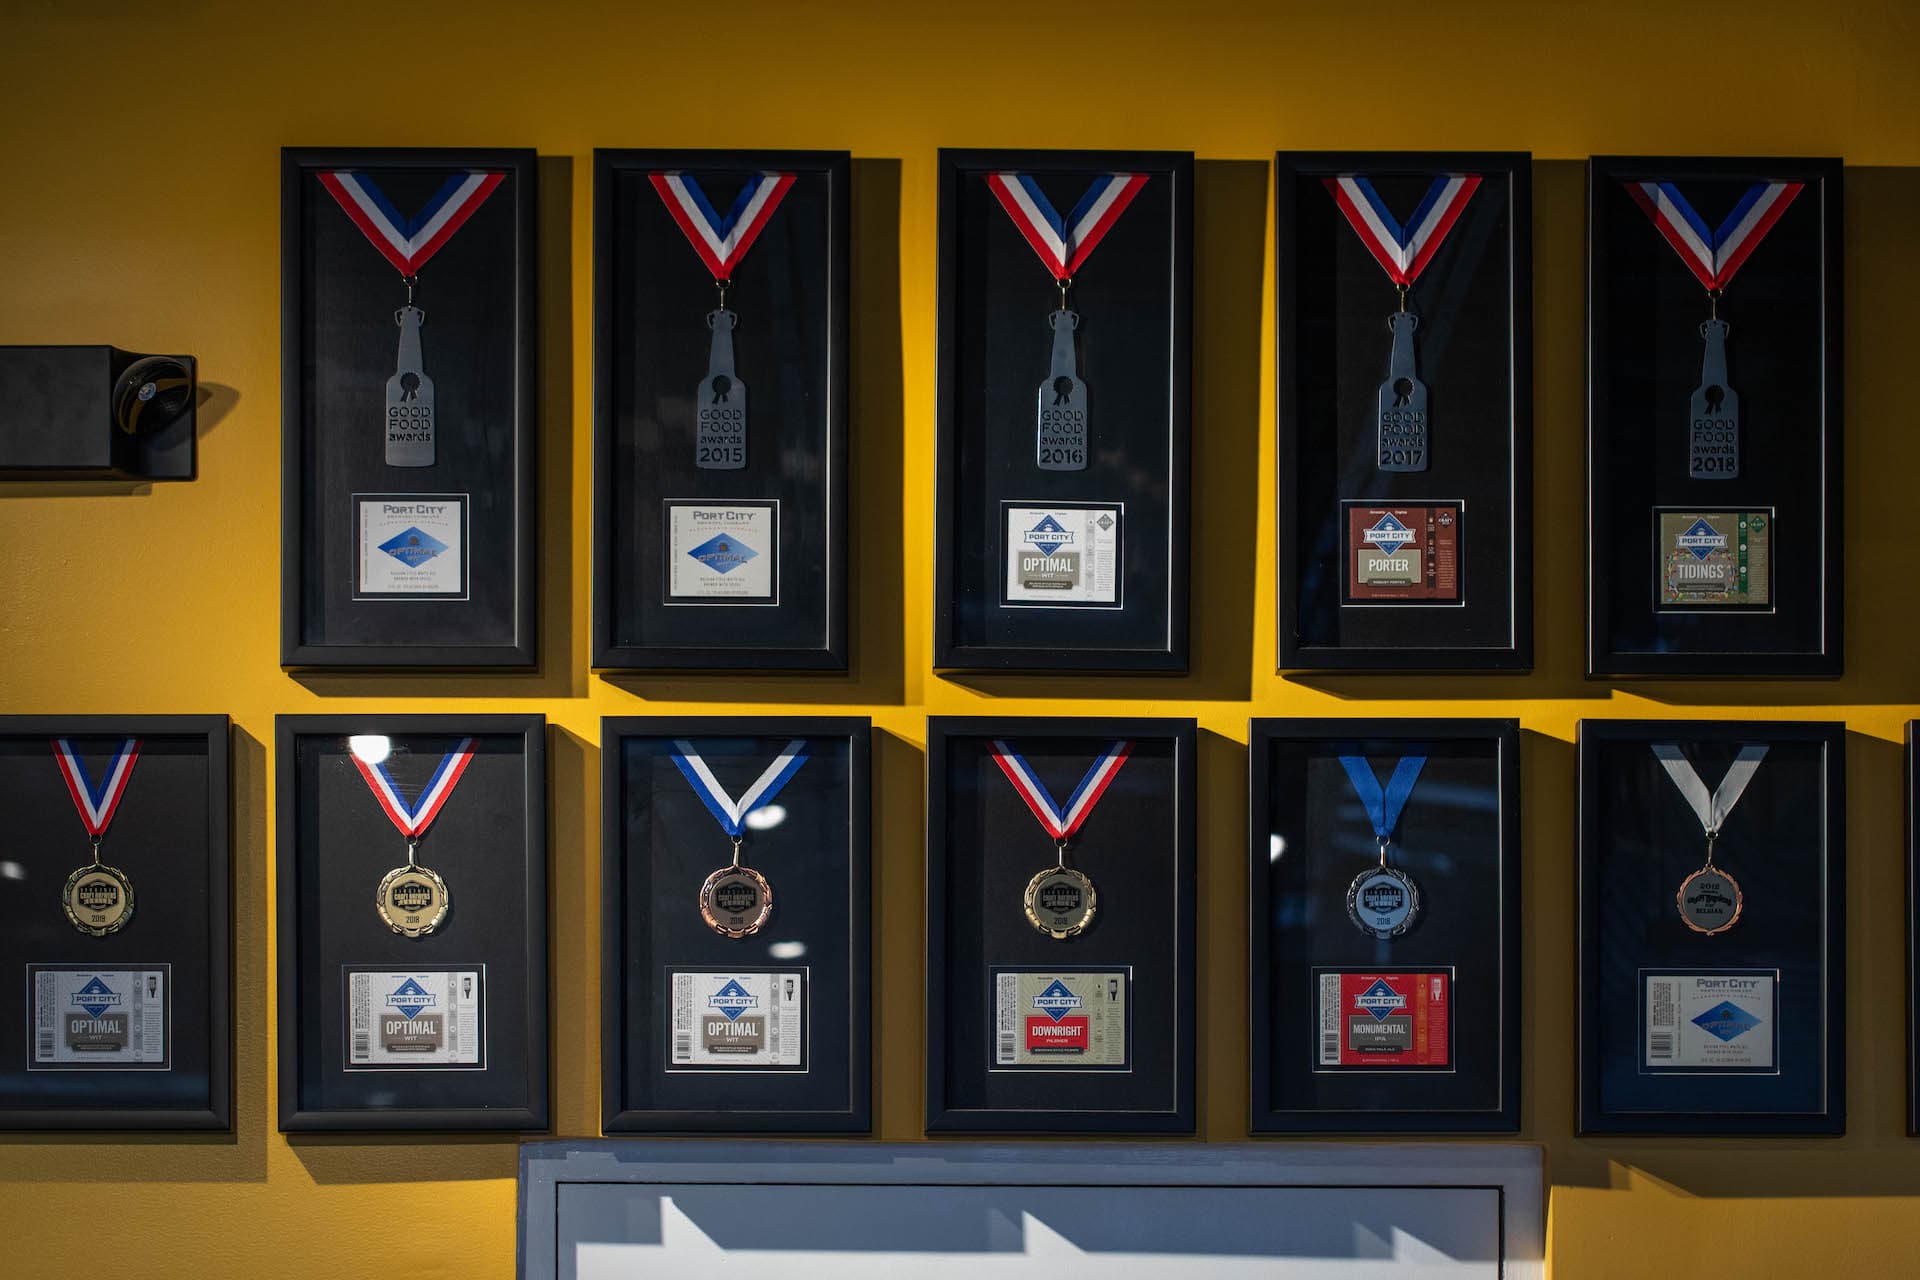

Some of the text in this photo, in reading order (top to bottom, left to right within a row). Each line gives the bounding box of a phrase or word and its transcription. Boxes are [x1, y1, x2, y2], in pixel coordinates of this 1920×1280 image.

[389, 406, 431, 417] GOOD
[700, 409, 742, 420] GOOD
[1042, 410, 1083, 421] GOOD
[1383, 411, 1425, 423] GOOD
[389, 419, 431, 430] FOOD
[701, 422, 742, 432] FOOD
[1042, 423, 1083, 434] FOOD
[1383, 424, 1425, 435] FOOD
[1694, 419, 1736, 430] GOOD
[389, 431, 431, 442] awards
[700, 433, 742, 444] awards
[1041, 435, 1083, 446] awards
[1382, 436, 1424, 448] awards
[1694, 431, 1735, 442] FOOD
[700, 447, 743, 462] 2015
[1041, 448, 1083, 464] 2016
[1382, 450, 1423, 465] 2017
[1693, 457, 1736, 472] 2018
[383, 504, 444, 514] PORT CITY
[693, 511, 753, 521] PORT CITY
[1023, 557, 1073, 572] OPTIMAL
[1369, 559, 1409, 572] PORTER
[1678, 564, 1724, 579] TIDINGS
[1696, 978, 1757, 988] PORT CITY
[71, 1020, 121, 1034] OPTIMAL
[386, 1021, 436, 1035] OPTIMAL
[708, 1022, 758, 1036] OPTIMAL
[1032, 1026, 1081, 1037] DOWNRIGHT
[1353, 1024, 1406, 1034] MONUMENTAL
